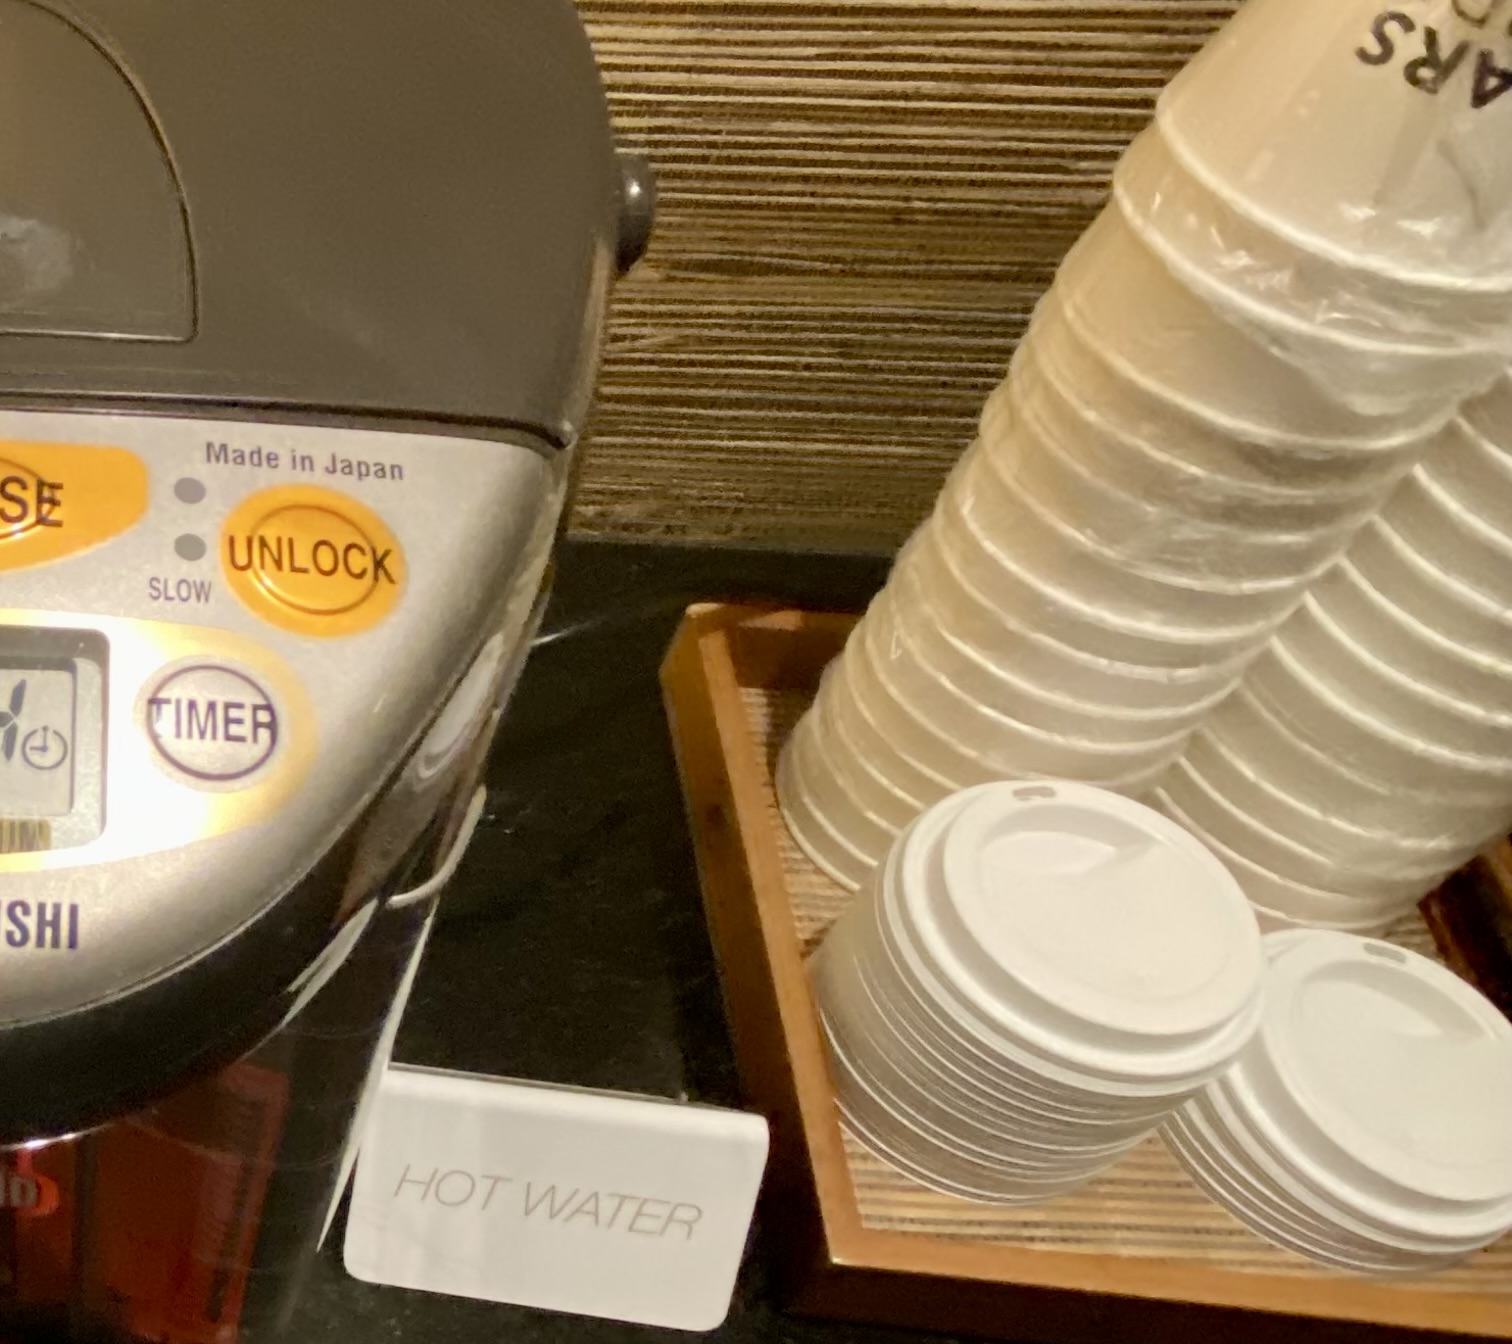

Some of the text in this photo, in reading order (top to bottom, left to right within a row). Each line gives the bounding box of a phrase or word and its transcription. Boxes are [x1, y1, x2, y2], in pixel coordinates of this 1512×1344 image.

[1355, 11, 1512, 108] ARS
[206, 441, 405, 481] Made in Japan
[228, 535, 397, 586] UNLOCK
[148, 576, 213, 604] SLOW
[147, 696, 279, 747] TIMER
[393, 1163, 704, 1242] HOT WATER
